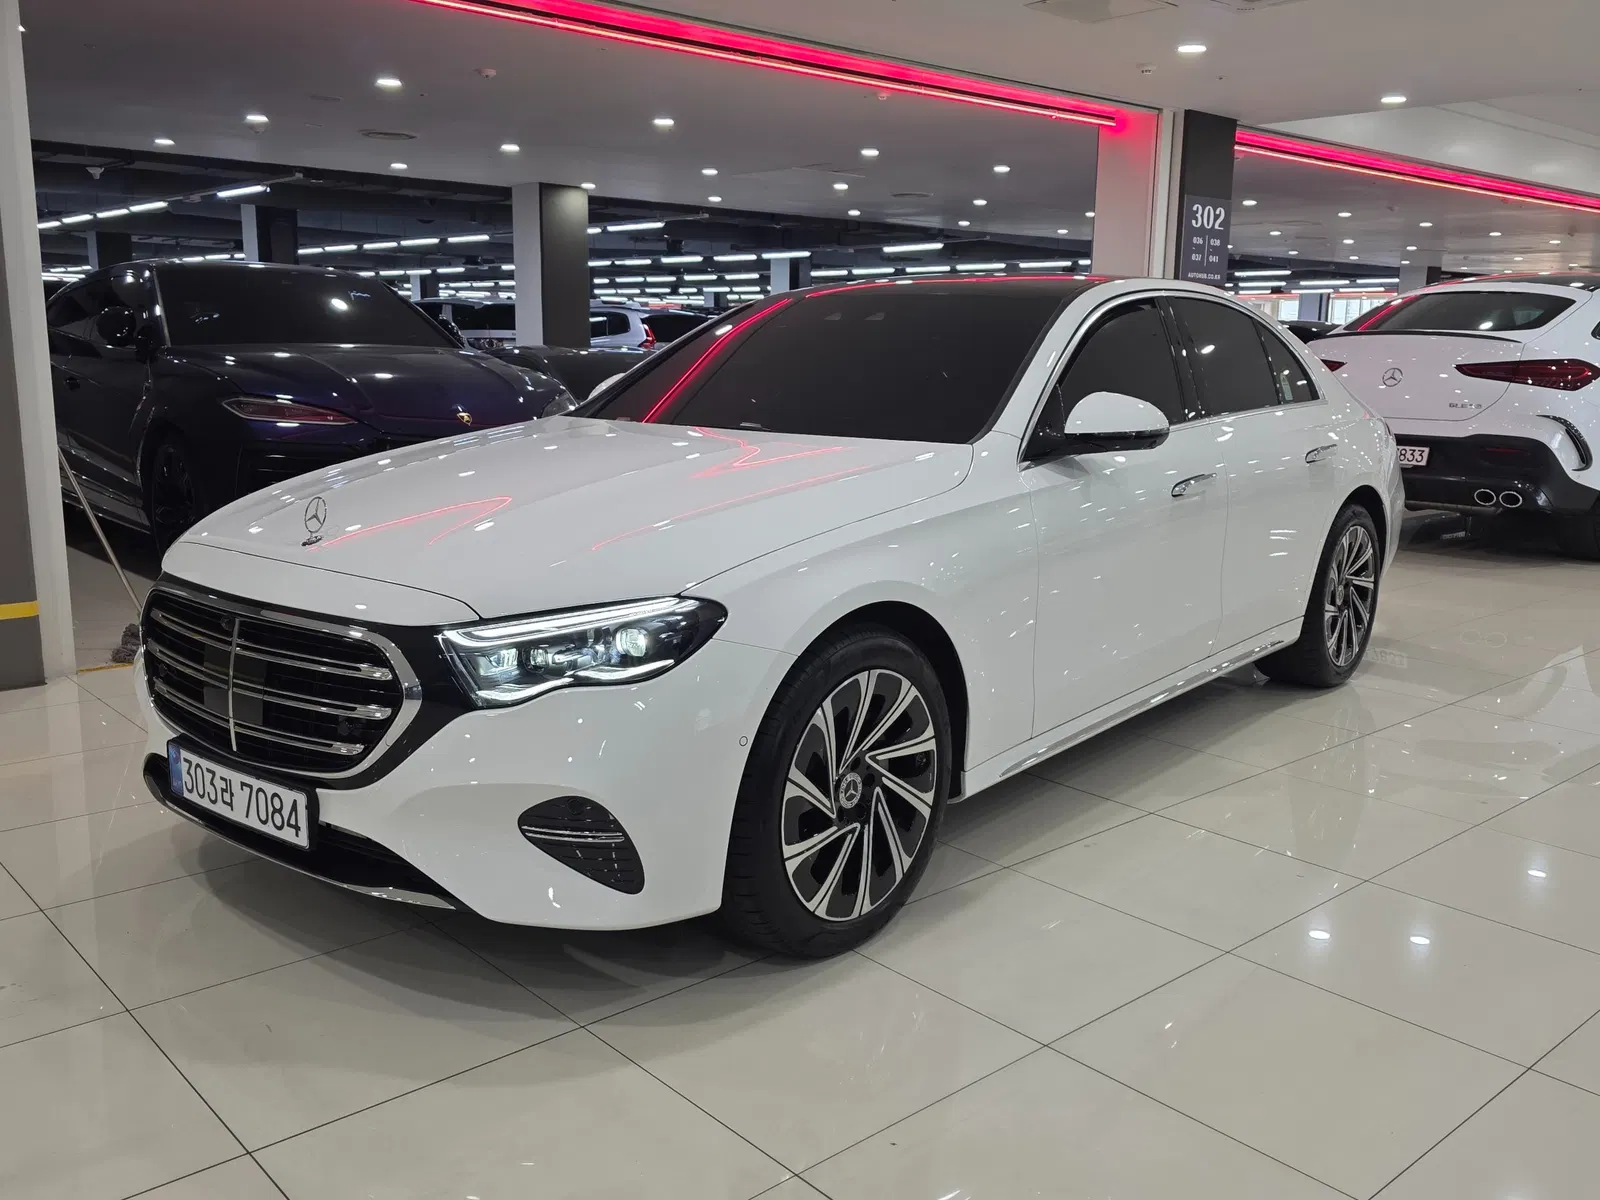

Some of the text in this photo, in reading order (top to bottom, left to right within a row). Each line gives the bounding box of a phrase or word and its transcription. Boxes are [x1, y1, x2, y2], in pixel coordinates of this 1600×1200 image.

[1191, 204, 1225, 230] 302
[1210, 238, 1220, 246] 038
[1191, 253, 1202, 261] 037
[1396, 447, 1425, 463] 833
[183, 757, 301, 838] 303라 7084
